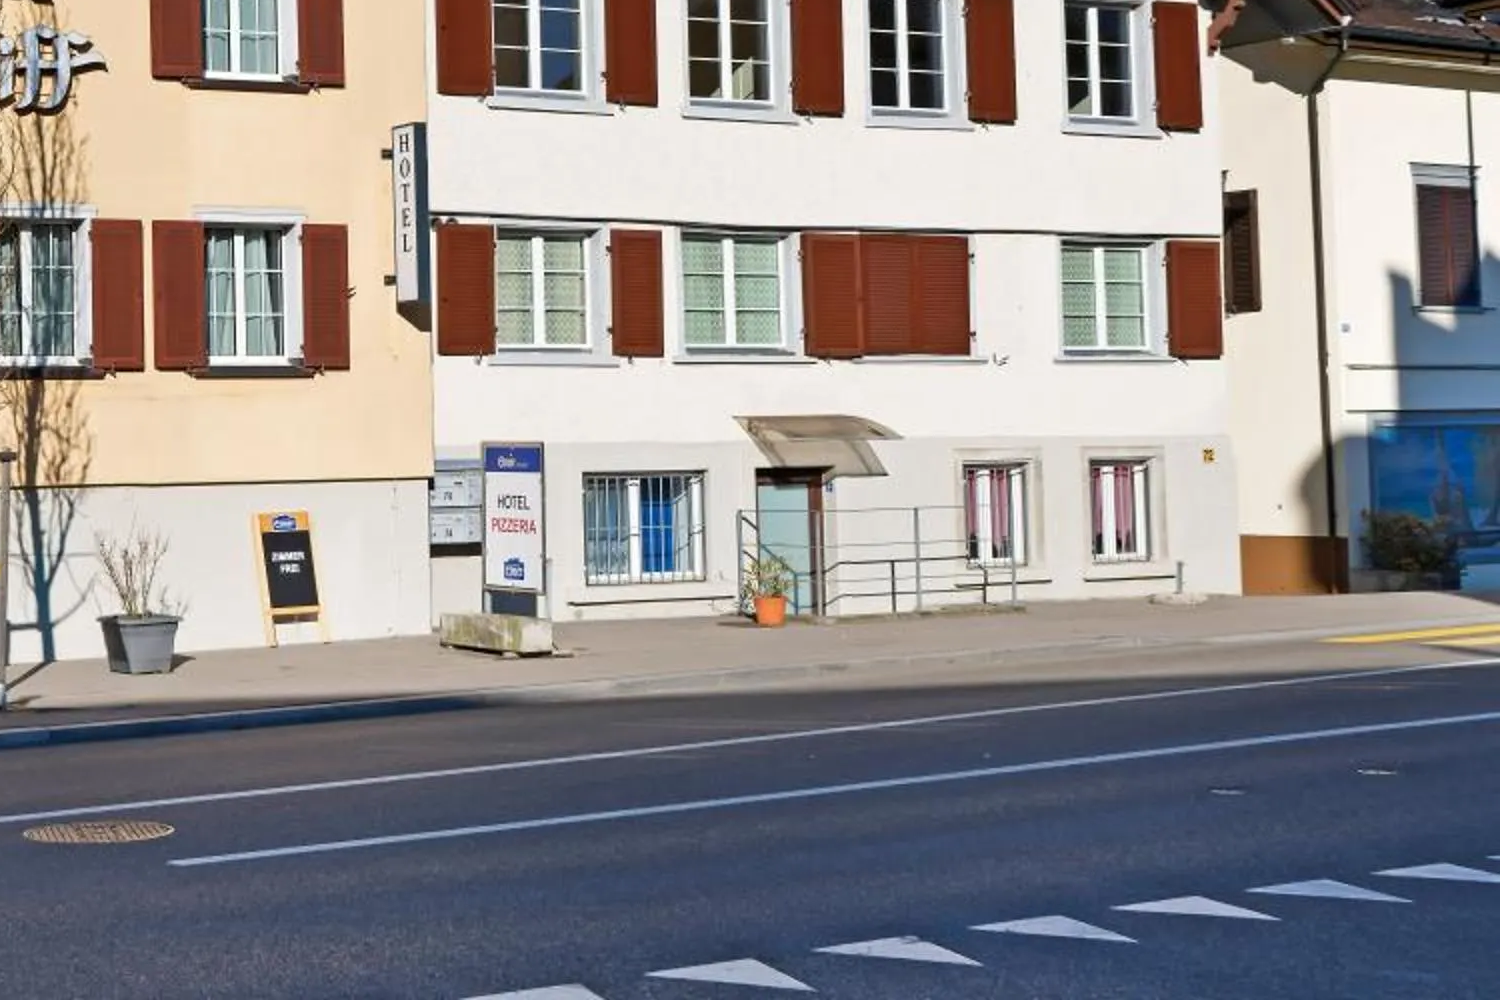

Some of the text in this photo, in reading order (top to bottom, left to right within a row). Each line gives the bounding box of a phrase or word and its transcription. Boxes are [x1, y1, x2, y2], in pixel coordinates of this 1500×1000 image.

[398, 133, 412, 253] HOTEL
[497, 494, 531, 511] HOTEL
[491, 517, 537, 535] PIZZERIA
